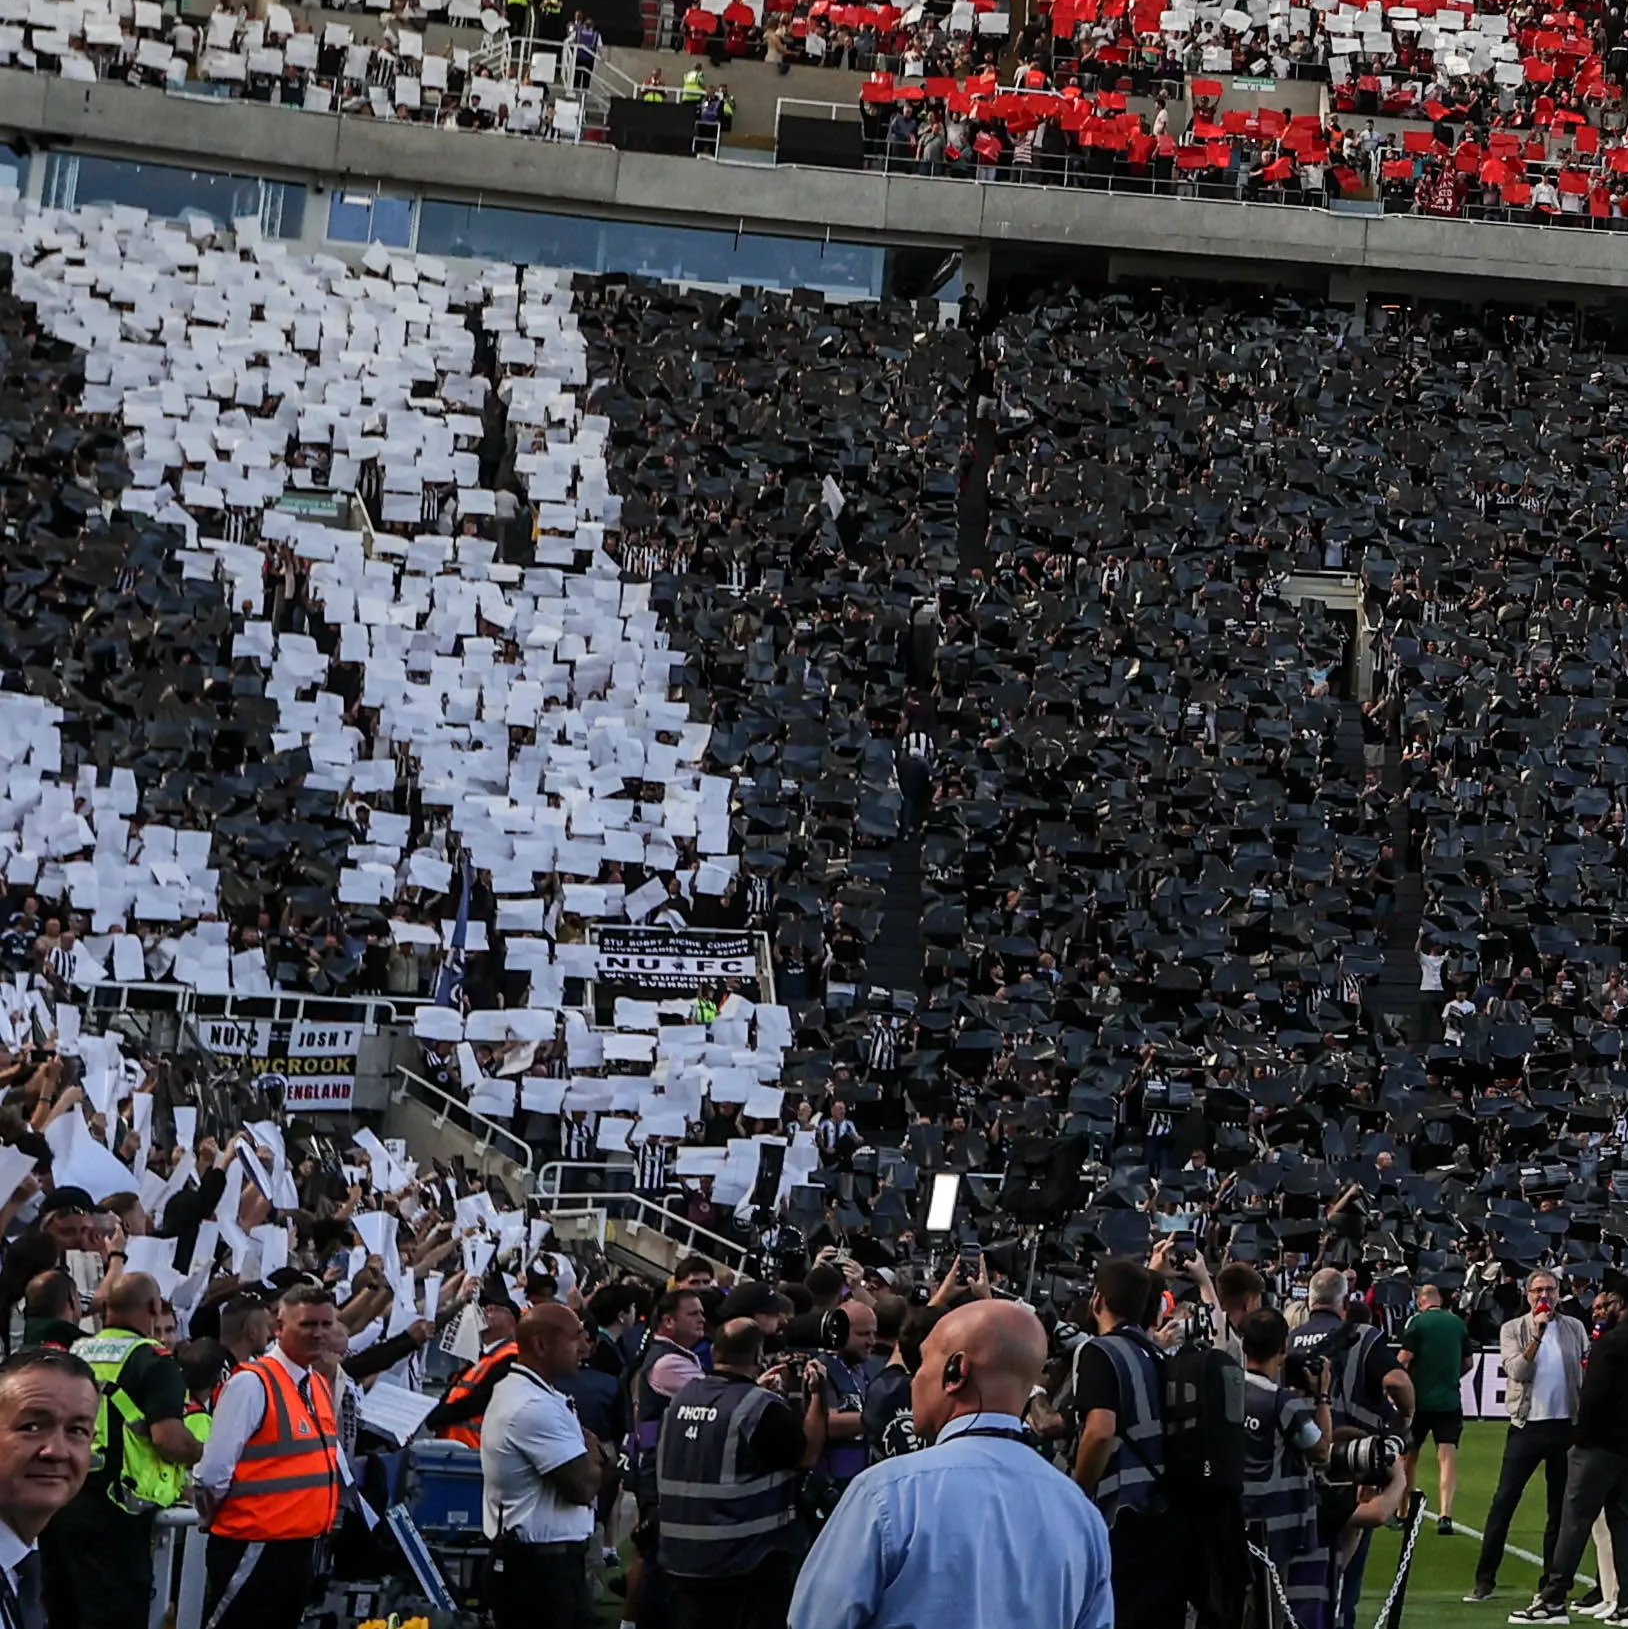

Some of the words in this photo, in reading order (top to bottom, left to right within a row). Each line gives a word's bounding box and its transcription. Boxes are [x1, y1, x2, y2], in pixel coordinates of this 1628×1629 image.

[298, 1031, 339, 1048] JOSH
[344, 1030, 353, 1046] T
[287, 1083, 351, 1100] ENGLAND
[1293, 1332, 1329, 1348] PHO
[677, 1405, 718, 1422] PHOTO
